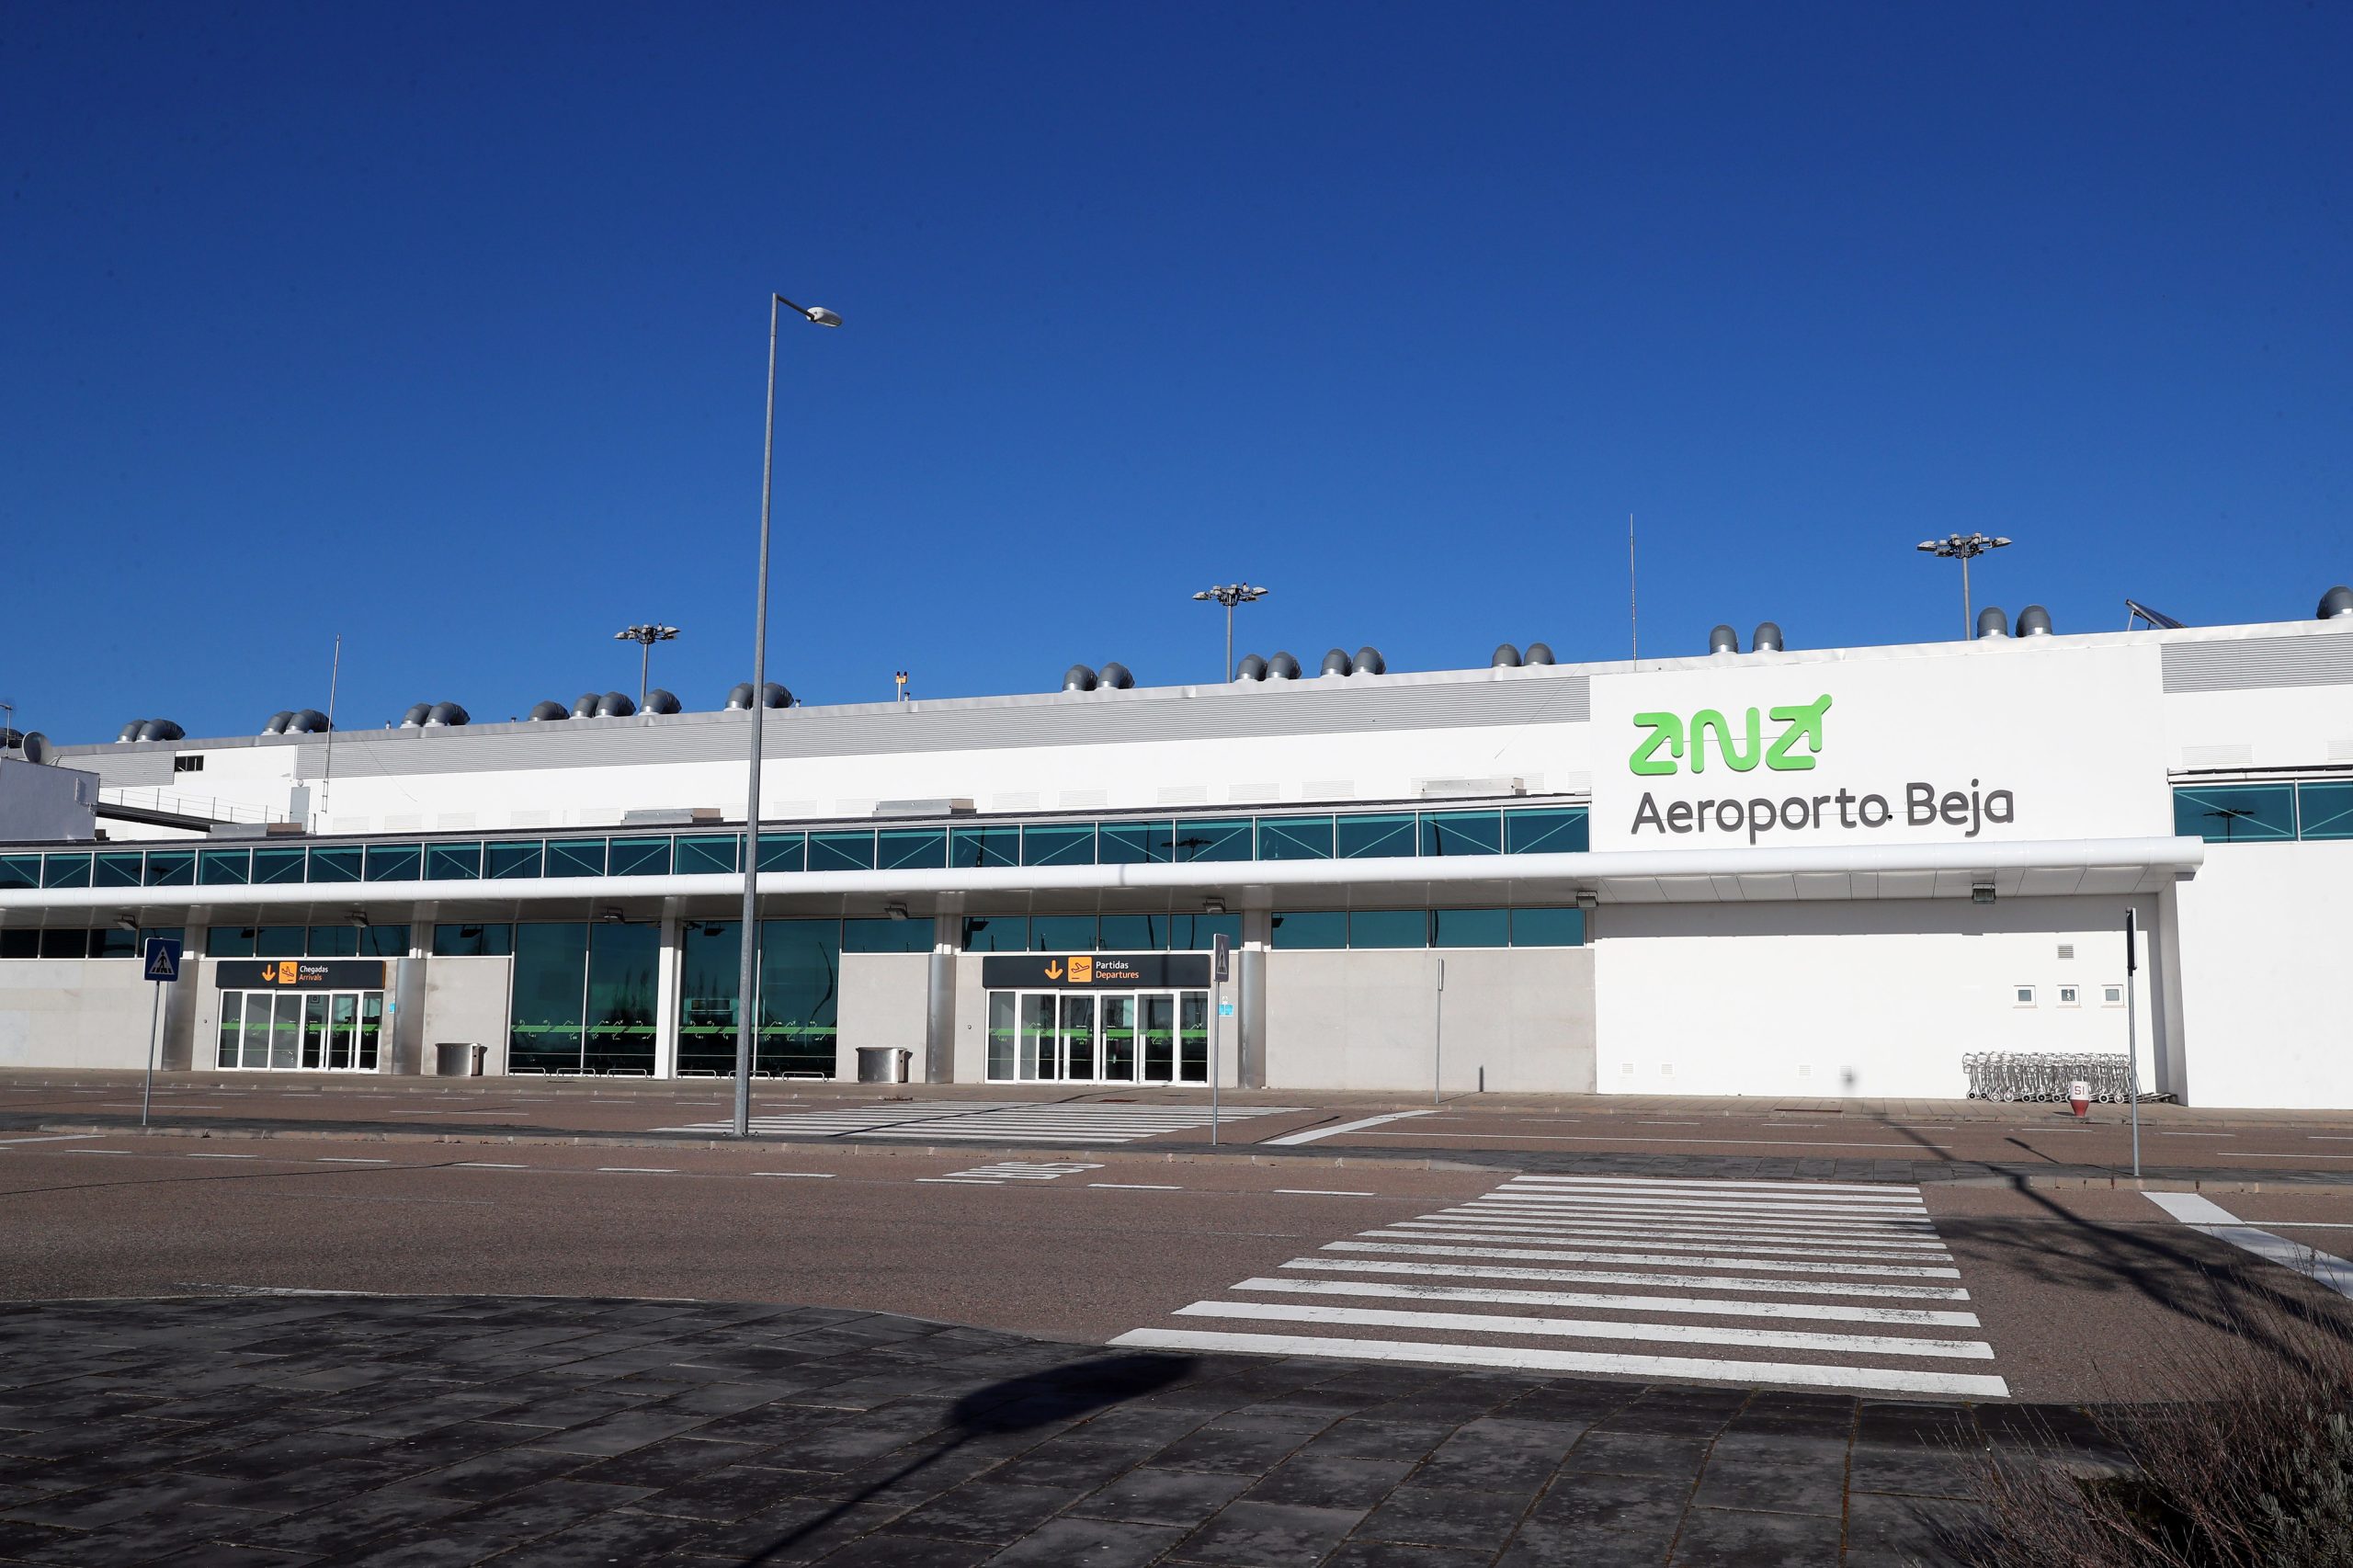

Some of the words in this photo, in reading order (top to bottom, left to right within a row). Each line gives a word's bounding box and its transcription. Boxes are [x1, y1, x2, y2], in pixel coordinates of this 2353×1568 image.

[1631, 788, 1889, 846] Aeroporto
[1905, 778, 2014, 838] Beja
[299, 965, 329, 975] Chegadas
[1096, 960, 1129, 970] Partidas
[1096, 971, 1140, 981] Departures
[942, 1161, 1105, 1180] BUS
